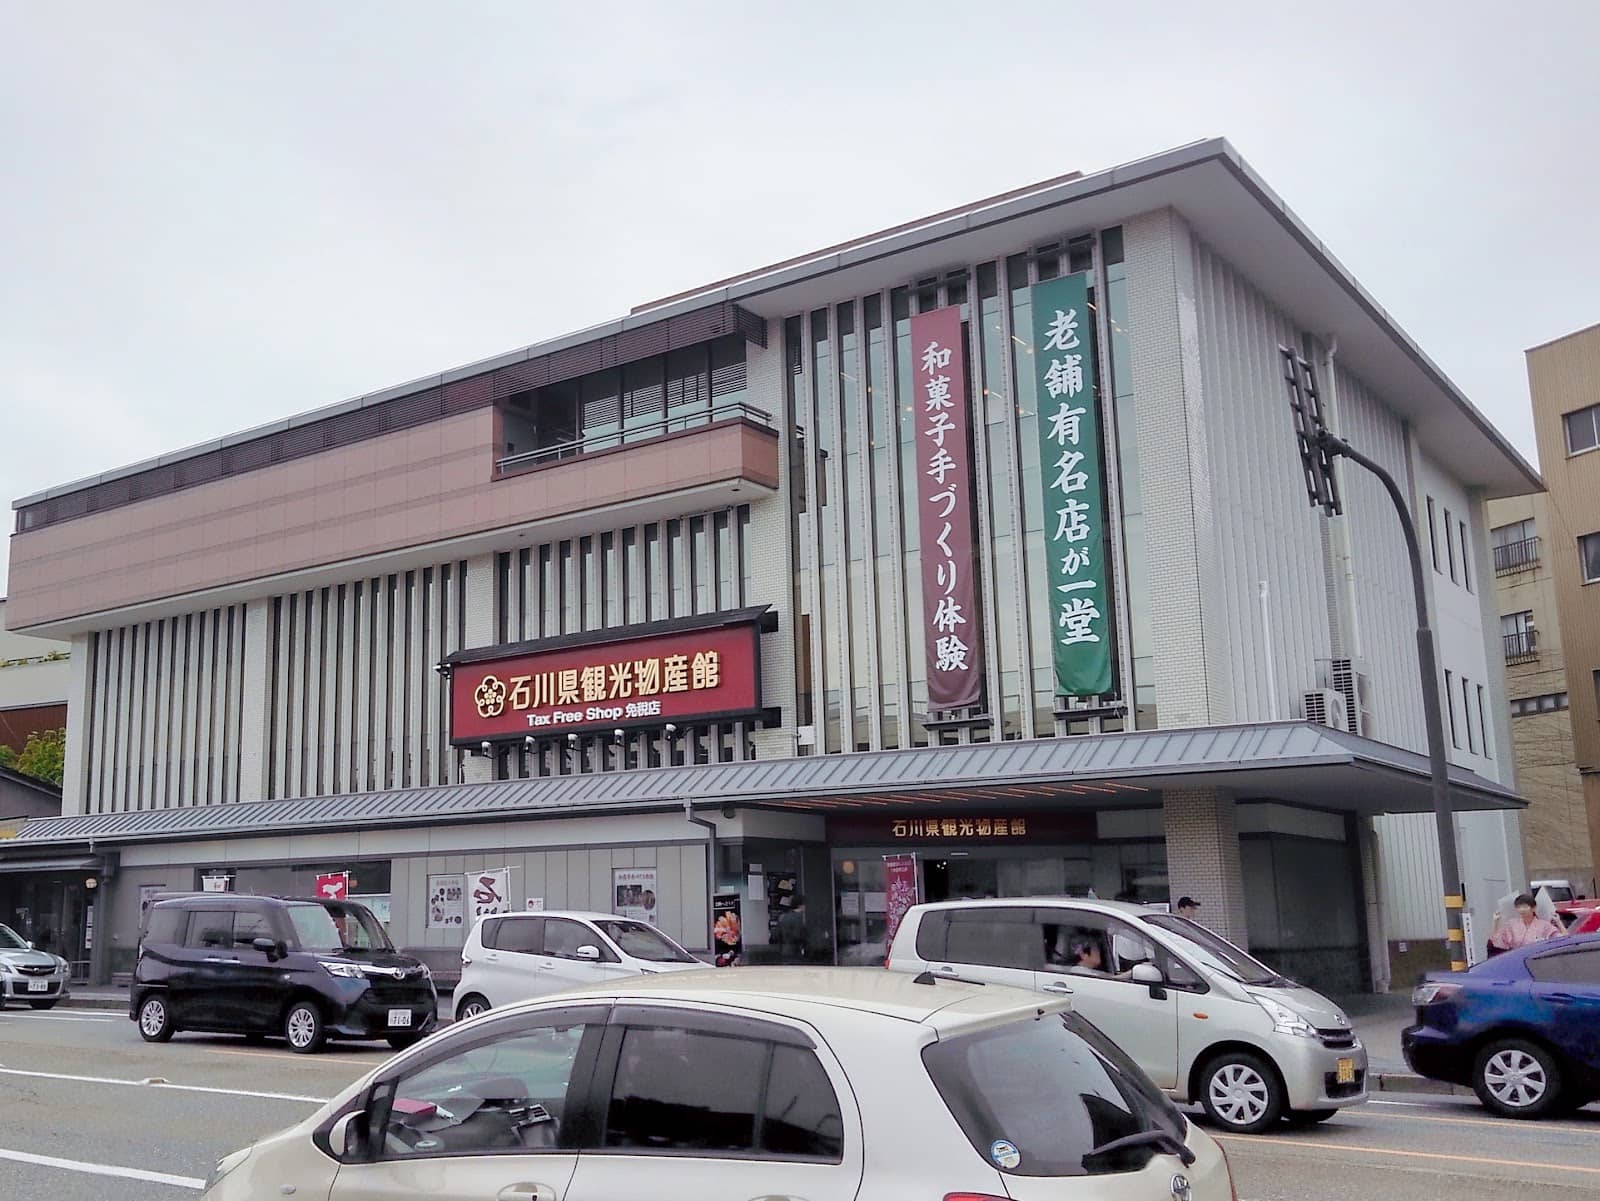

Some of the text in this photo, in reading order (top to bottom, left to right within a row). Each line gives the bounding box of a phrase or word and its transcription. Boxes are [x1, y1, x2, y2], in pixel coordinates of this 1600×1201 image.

[921, 340, 969, 672] 和菓子手づくり体験
[1043, 308, 1101, 646] 老舗有名店が一堂
[508, 650, 720, 710] 石川県観光物産館
[527, 700, 661, 727] Tax Free Shop 免税店
[892, 818, 1027, 837] 石川県観光物産館
